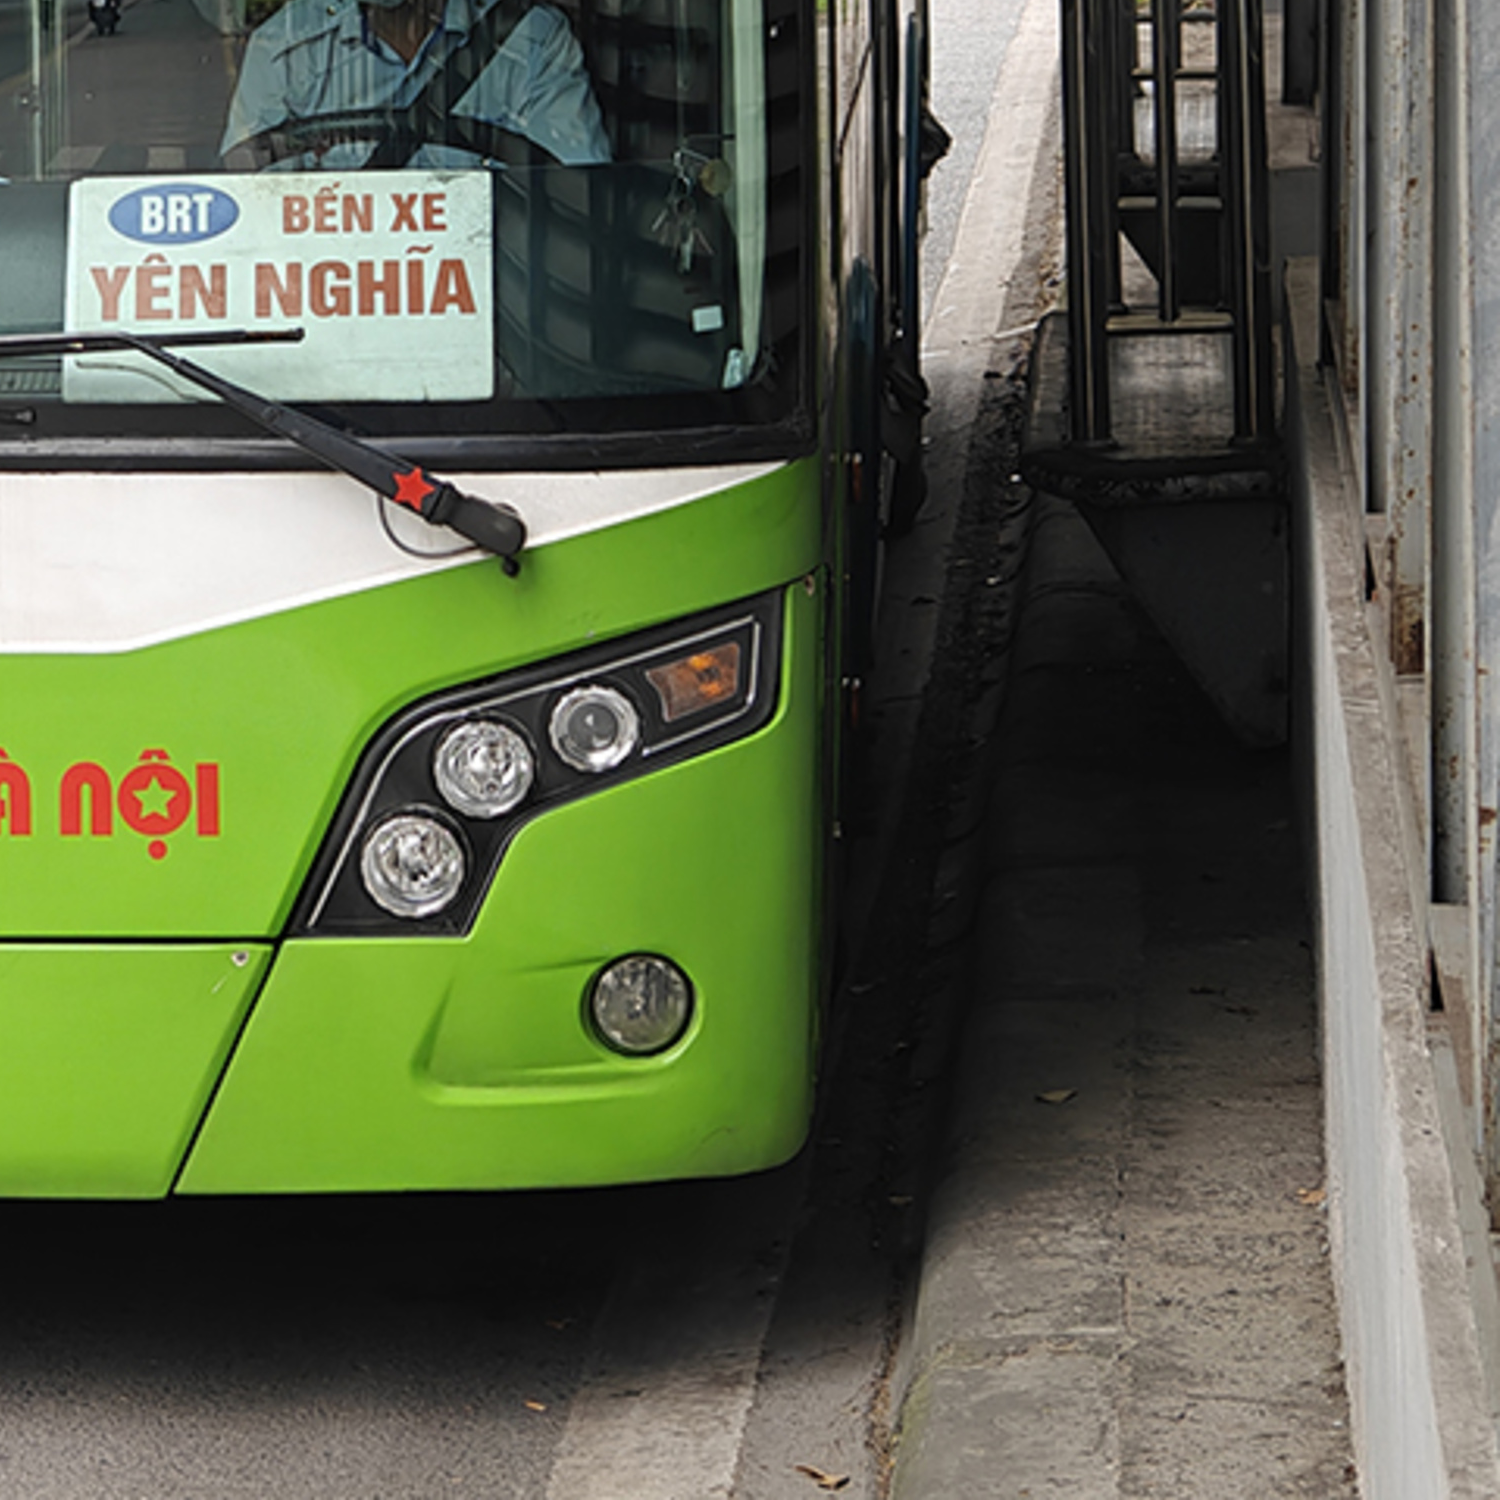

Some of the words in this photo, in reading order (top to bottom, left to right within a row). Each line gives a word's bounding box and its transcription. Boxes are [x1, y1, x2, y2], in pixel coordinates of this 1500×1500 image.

[140, 193, 213, 235] BRT
[282, 182, 374, 235] BẾN
[389, 193, 447, 232] XE
[89, 253, 228, 321] YÊN
[254, 244, 477, 318] NGHĨA
[59, 748, 220, 860] NỘI
